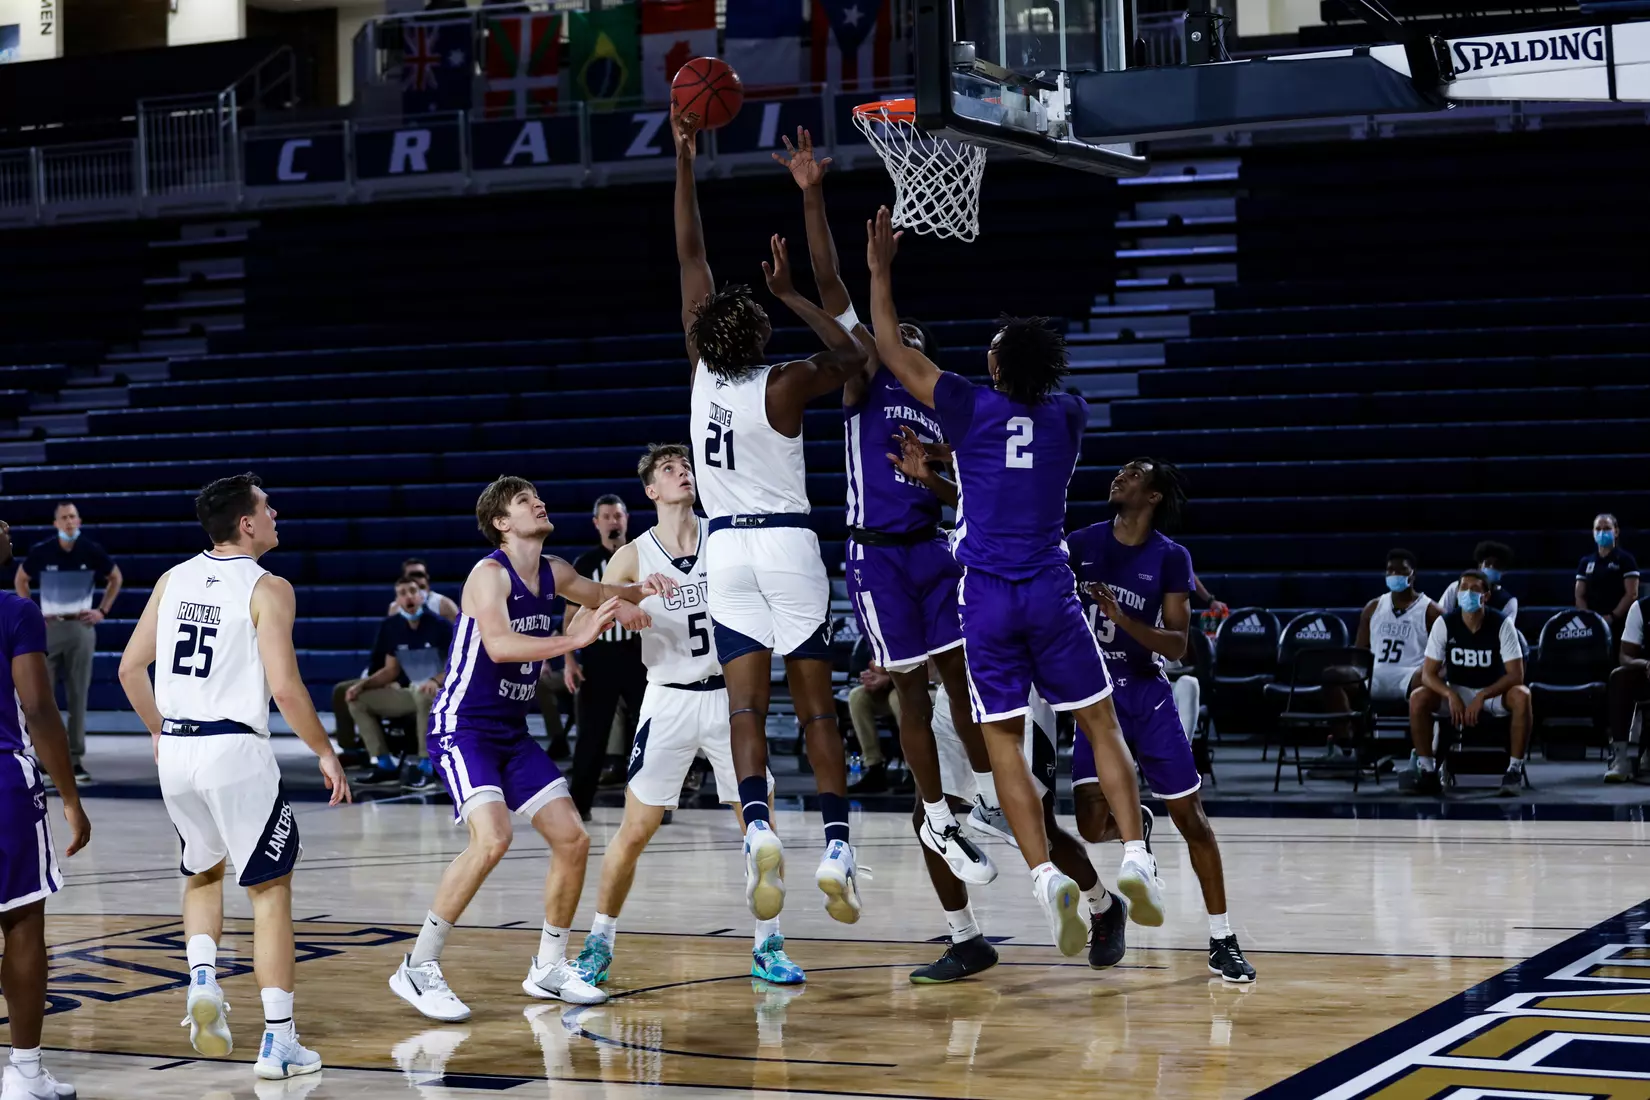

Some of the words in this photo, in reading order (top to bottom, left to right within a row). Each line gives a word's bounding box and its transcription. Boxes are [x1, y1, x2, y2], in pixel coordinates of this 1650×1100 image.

[1454, 28, 1603, 75] SPALDING
[708, 401, 733, 428] WADE
[705, 422, 736, 471] 21
[1005, 416, 1034, 469] 2
[177, 601, 222, 625] ROWELL
[1088, 604, 1117, 644] 13
[687, 612, 711, 658] 5
[1232, 626, 1266, 635] adidas
[1296, 631, 1332, 640] adidas
[1556, 628, 1594, 640] adidas
[172, 623, 218, 678] 25
[1378, 639, 1405, 663] 35
[1450, 647, 1493, 668] CBU
[264, 800, 292, 862] LANCERS
